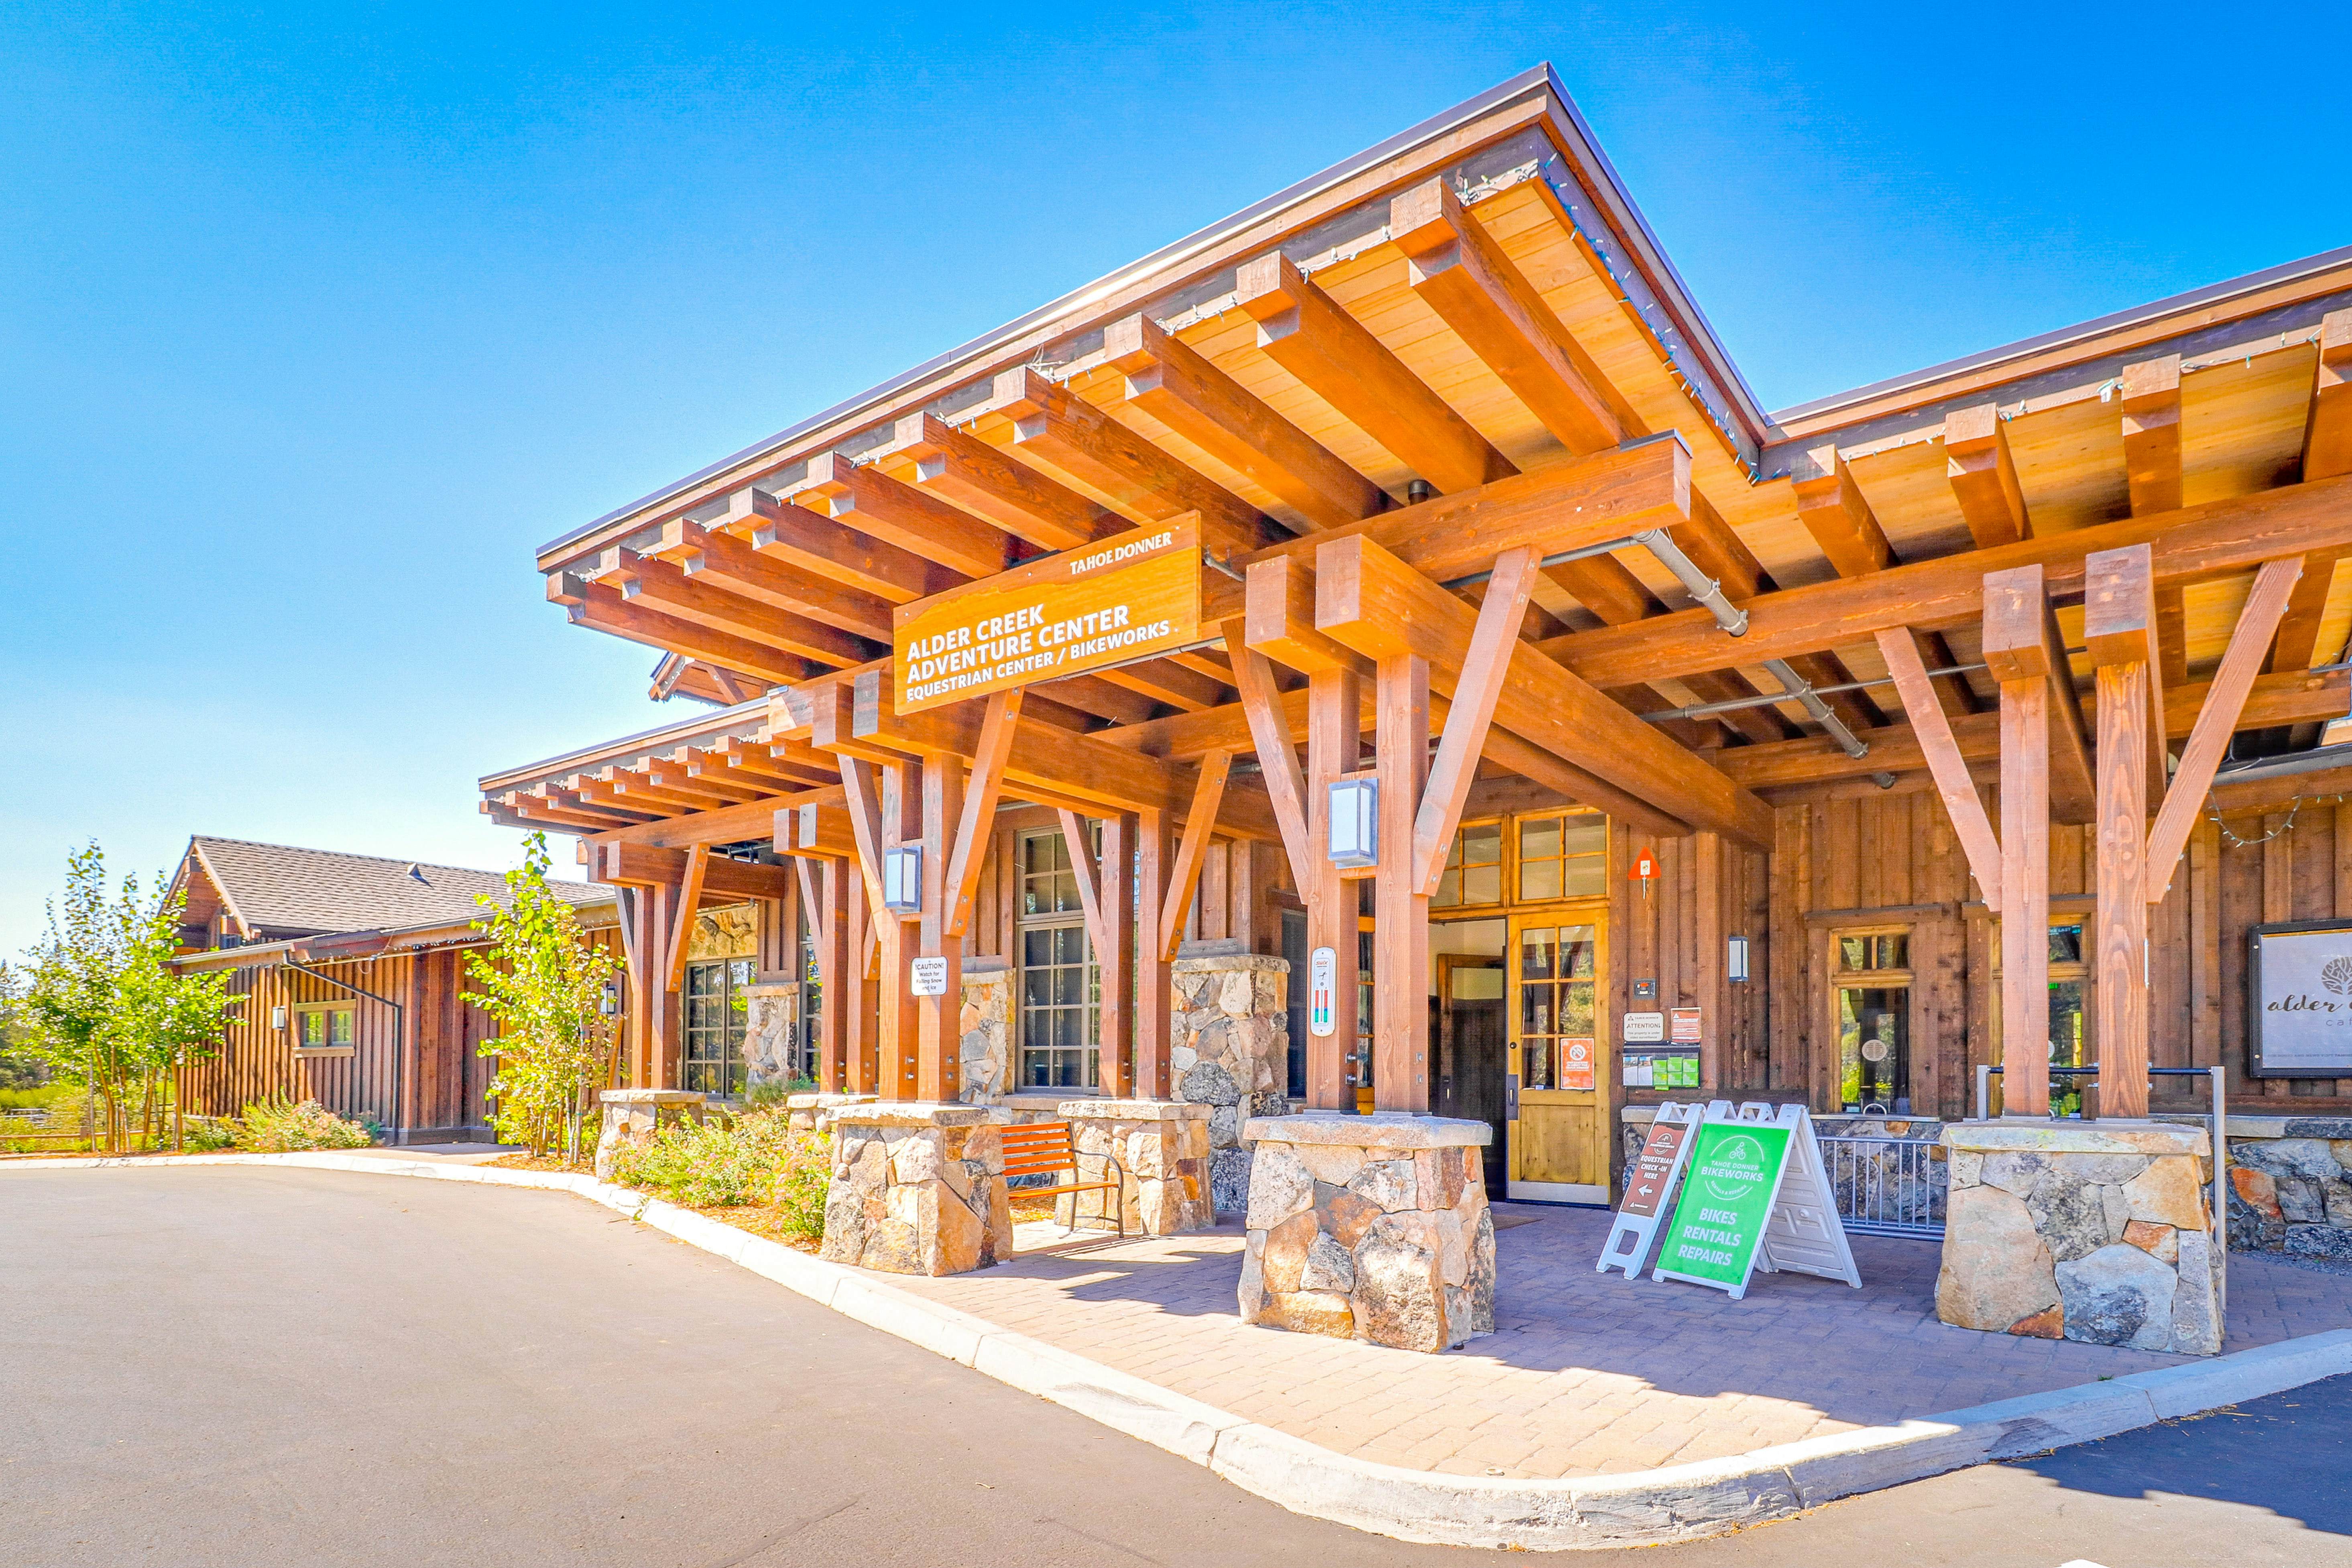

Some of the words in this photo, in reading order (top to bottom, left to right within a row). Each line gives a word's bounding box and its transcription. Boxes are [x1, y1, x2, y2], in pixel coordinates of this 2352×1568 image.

[1070, 550, 1113, 575] TAHOE
[1115, 531, 1172, 561] DONNER
[907, 627, 971, 662] ALDER
[977, 604, 1044, 641] CREEK
[907, 631, 1032, 684] ADVENTURE
[1039, 605, 1129, 647] CENTER
[907, 667, 993, 702] EQUESTRIAN
[996, 651, 1054, 678] CENTER
[1056, 647, 1066, 665] /
[1070, 620, 1170, 659] BIKEWORKS
[2267, 994, 2344, 1012] alder
[1640, 1155, 1674, 1164] EQUESTRIAN
[1701, 1166, 1764, 1182] BIKEWORKS
[1699, 1208, 1738, 1225] BIKES
[1683, 1225, 1742, 1247] RENTALS
[1678, 1244, 1733, 1265] REPAIRS
